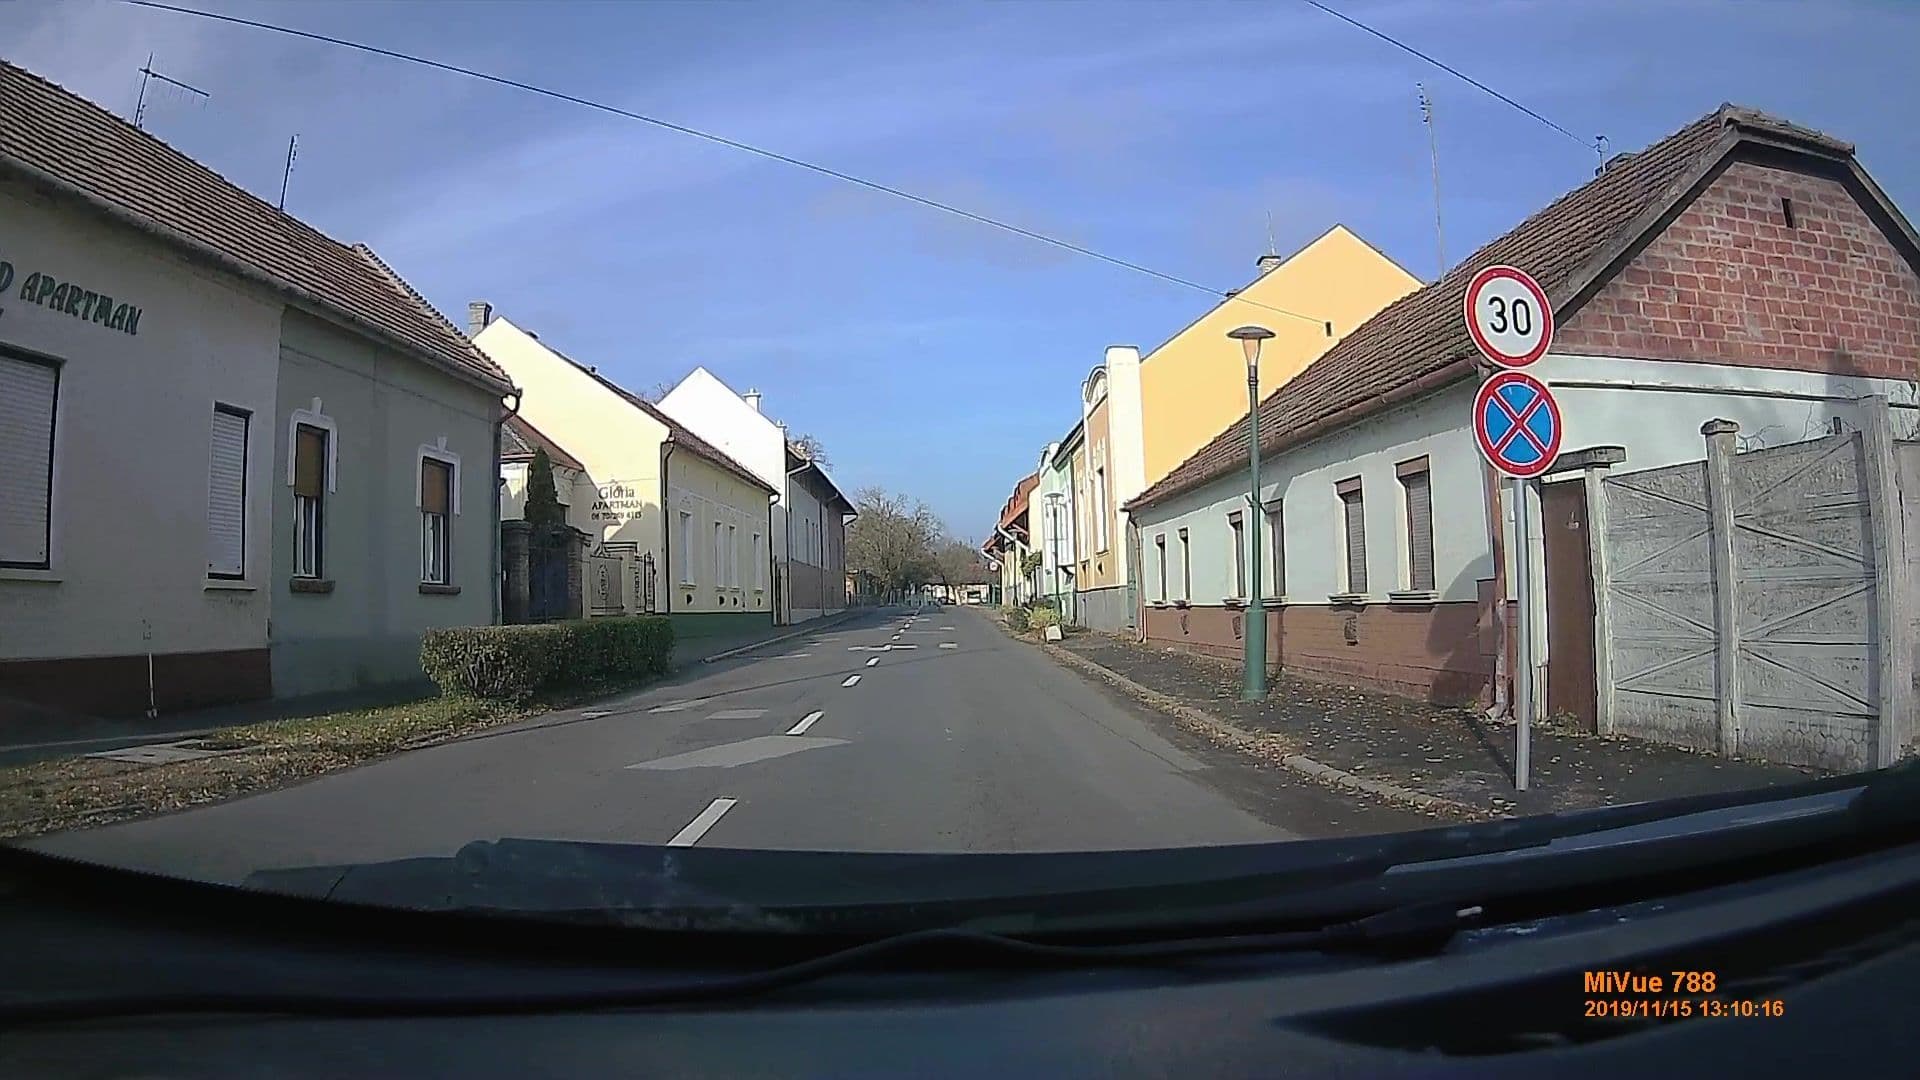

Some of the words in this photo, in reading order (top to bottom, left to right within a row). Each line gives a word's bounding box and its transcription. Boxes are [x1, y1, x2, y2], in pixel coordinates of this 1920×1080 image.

[20, 271, 142, 336] APARTMAN
[1488, 296, 1531, 336] 30
[591, 500, 643, 510] APARTMAN
